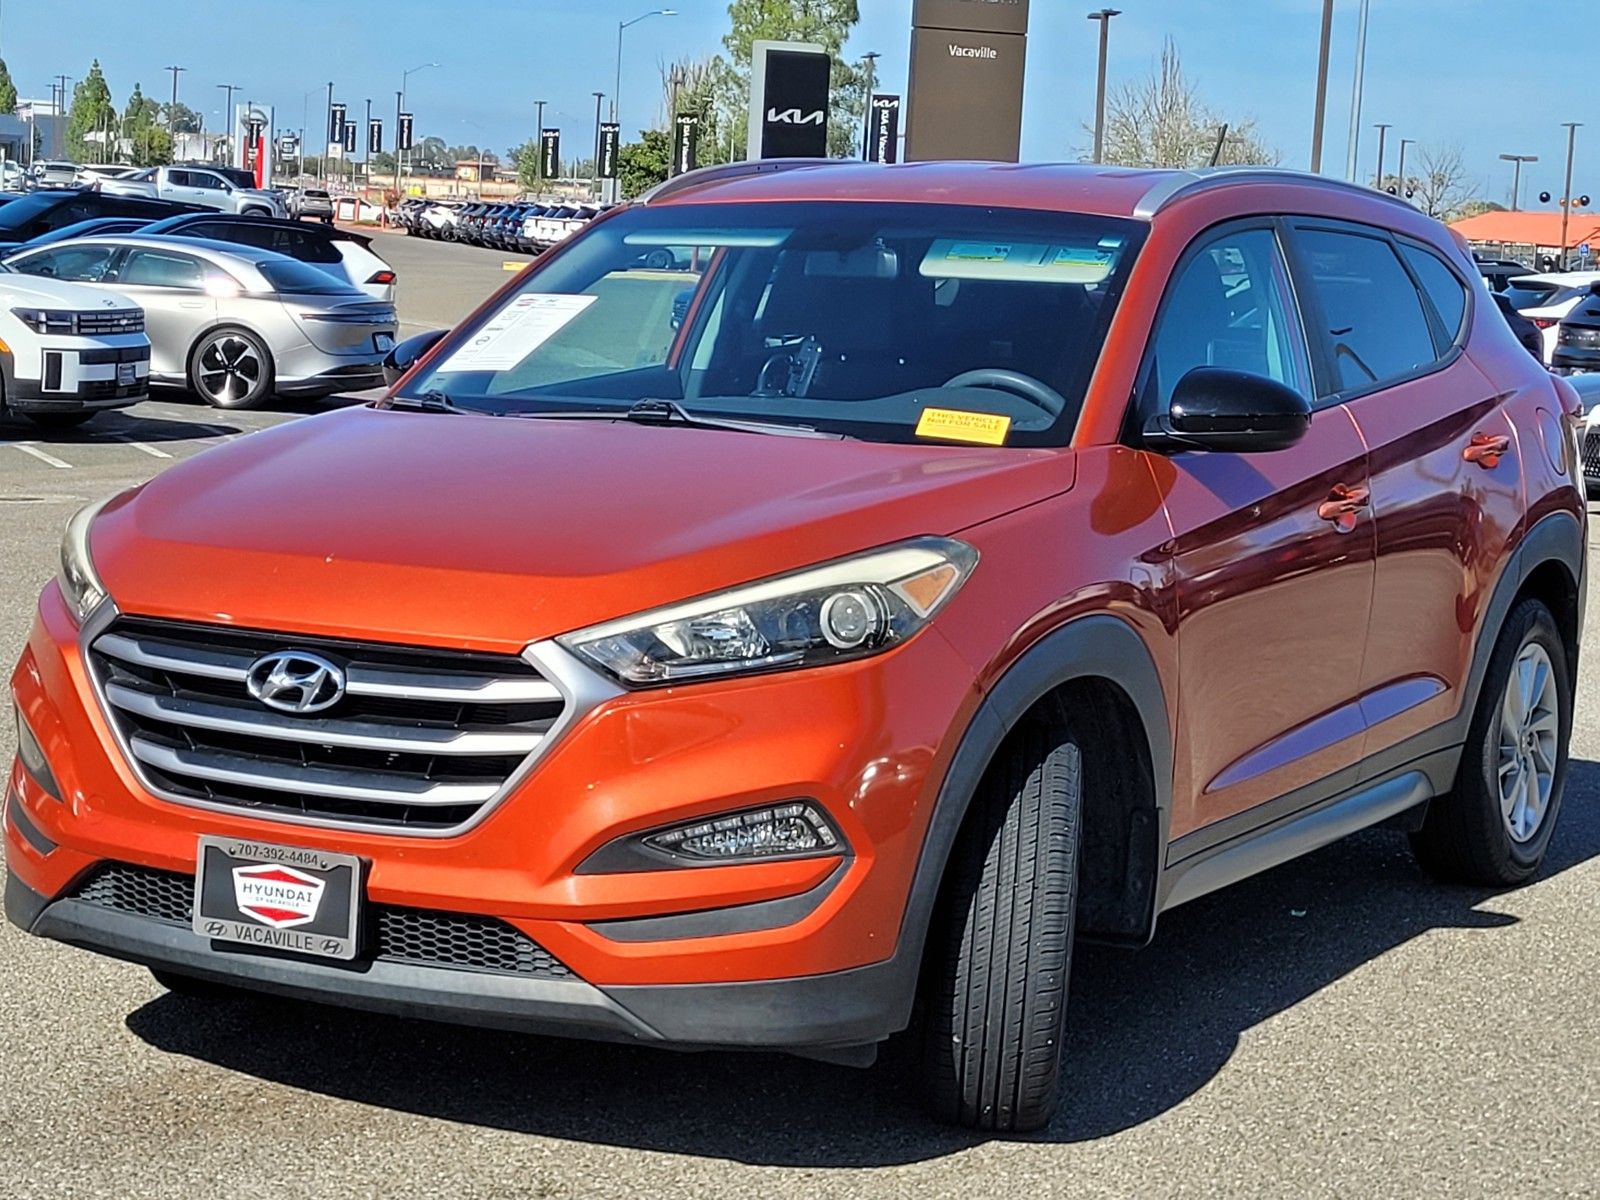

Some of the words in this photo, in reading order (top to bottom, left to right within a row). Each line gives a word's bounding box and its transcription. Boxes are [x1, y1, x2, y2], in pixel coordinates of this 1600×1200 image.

[948, 44, 997, 59] Vacaville
[767, 106, 824, 126] KIA
[880, 109, 890, 125] KIA
[973, 422, 999, 430] SALE
[238, 843, 319, 866] 707-392-4484
[242, 883, 313, 903] HYUNDAI
[234, 924, 313, 951] VACAVILLE
